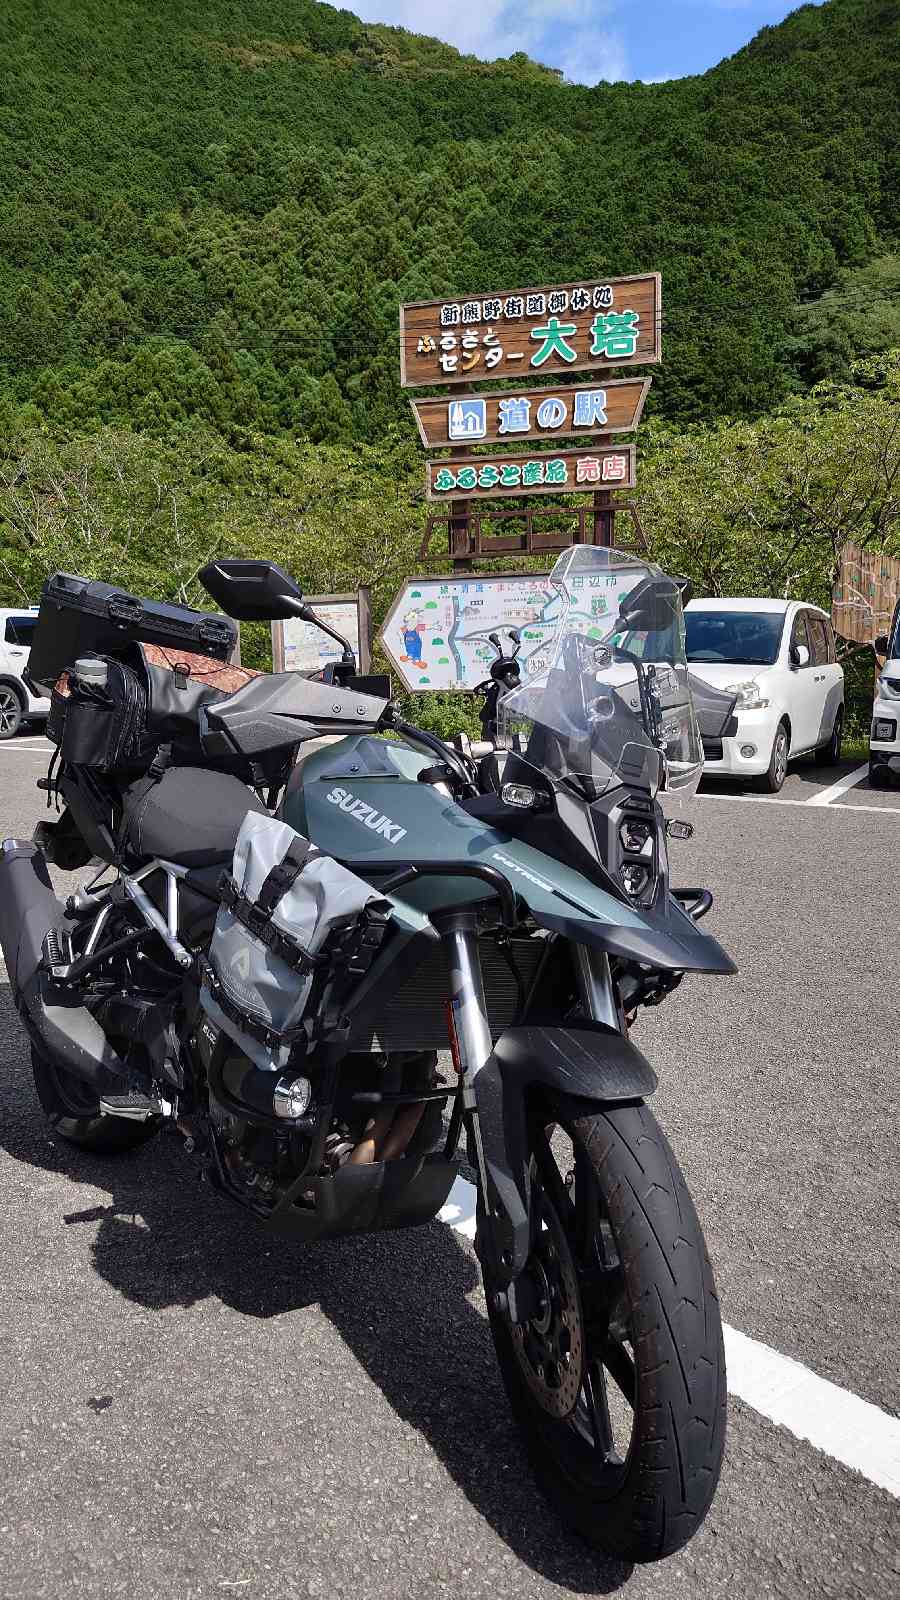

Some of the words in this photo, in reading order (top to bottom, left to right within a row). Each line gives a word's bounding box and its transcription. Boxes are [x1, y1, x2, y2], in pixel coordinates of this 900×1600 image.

[441, 286, 613, 325] 新熊野街道御休処
[417, 328, 500, 352] ふるさと
[530, 311, 639, 367] 大塔
[439, 348, 524, 371] センター
[499, 390, 608, 433] 道の駅
[576, 456, 626, 482] 売店
[326, 787, 407, 844] SUZUKI
